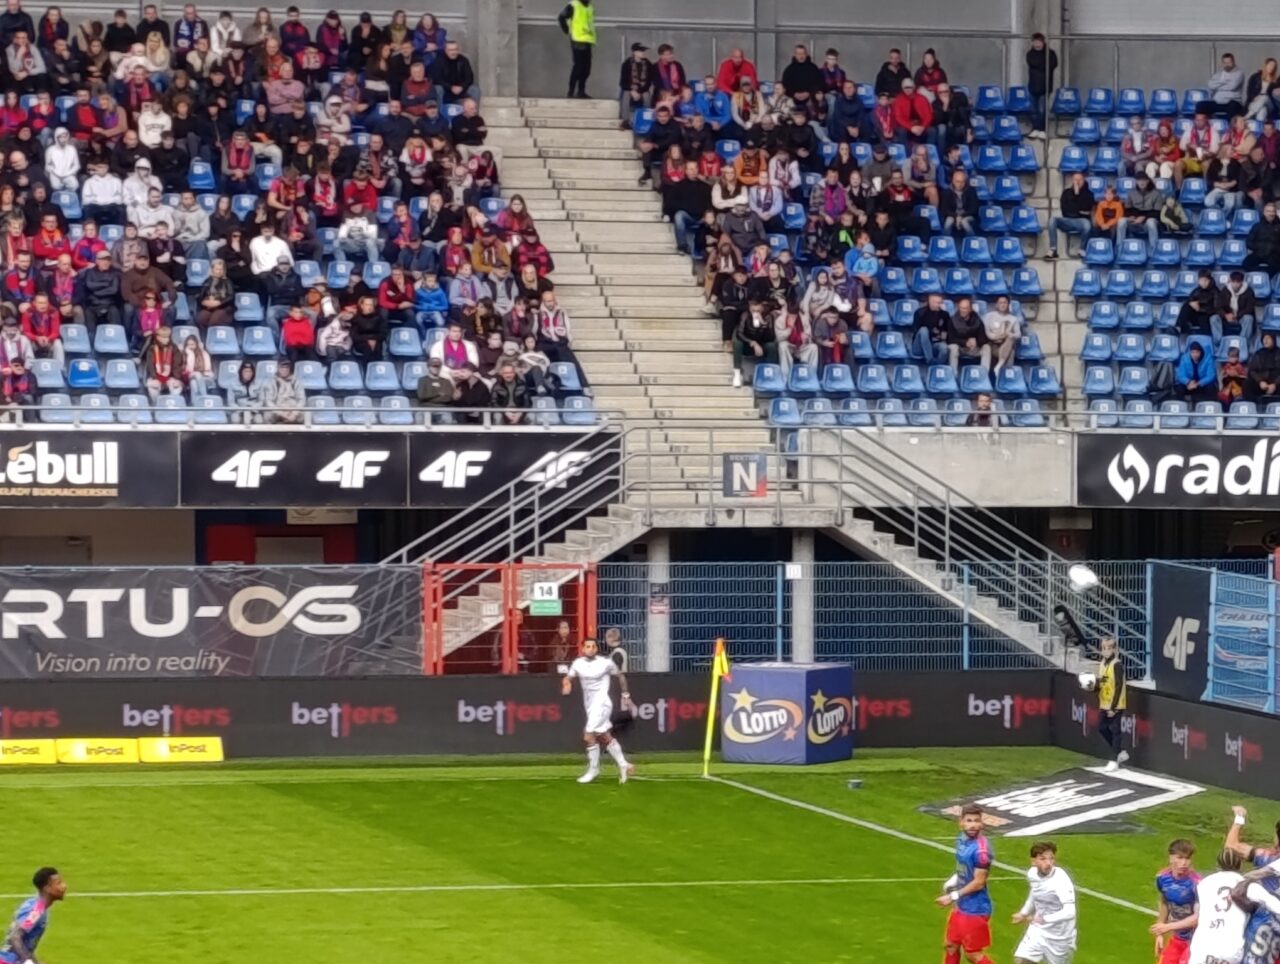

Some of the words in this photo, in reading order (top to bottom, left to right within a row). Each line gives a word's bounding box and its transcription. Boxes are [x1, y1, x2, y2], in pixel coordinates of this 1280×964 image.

[211, 450, 286, 488] 4F
[316, 450, 390, 488] 4F
[419, 450, 492, 488] 4F
[733, 462, 757, 491] N
[538, 586, 553, 597] 14
[1163, 616, 1200, 671] 4F
[35, 652, 100, 673] Vision
[106, 653, 151, 673] into
[156, 649, 231, 676] reality
[739, 708, 788, 734] LOTTO
[816, 704, 845, 734] LOTTO
[1, 745, 40, 755] InPost
[86, 746, 124, 756] InPost
[169, 743, 207, 753] InPost
